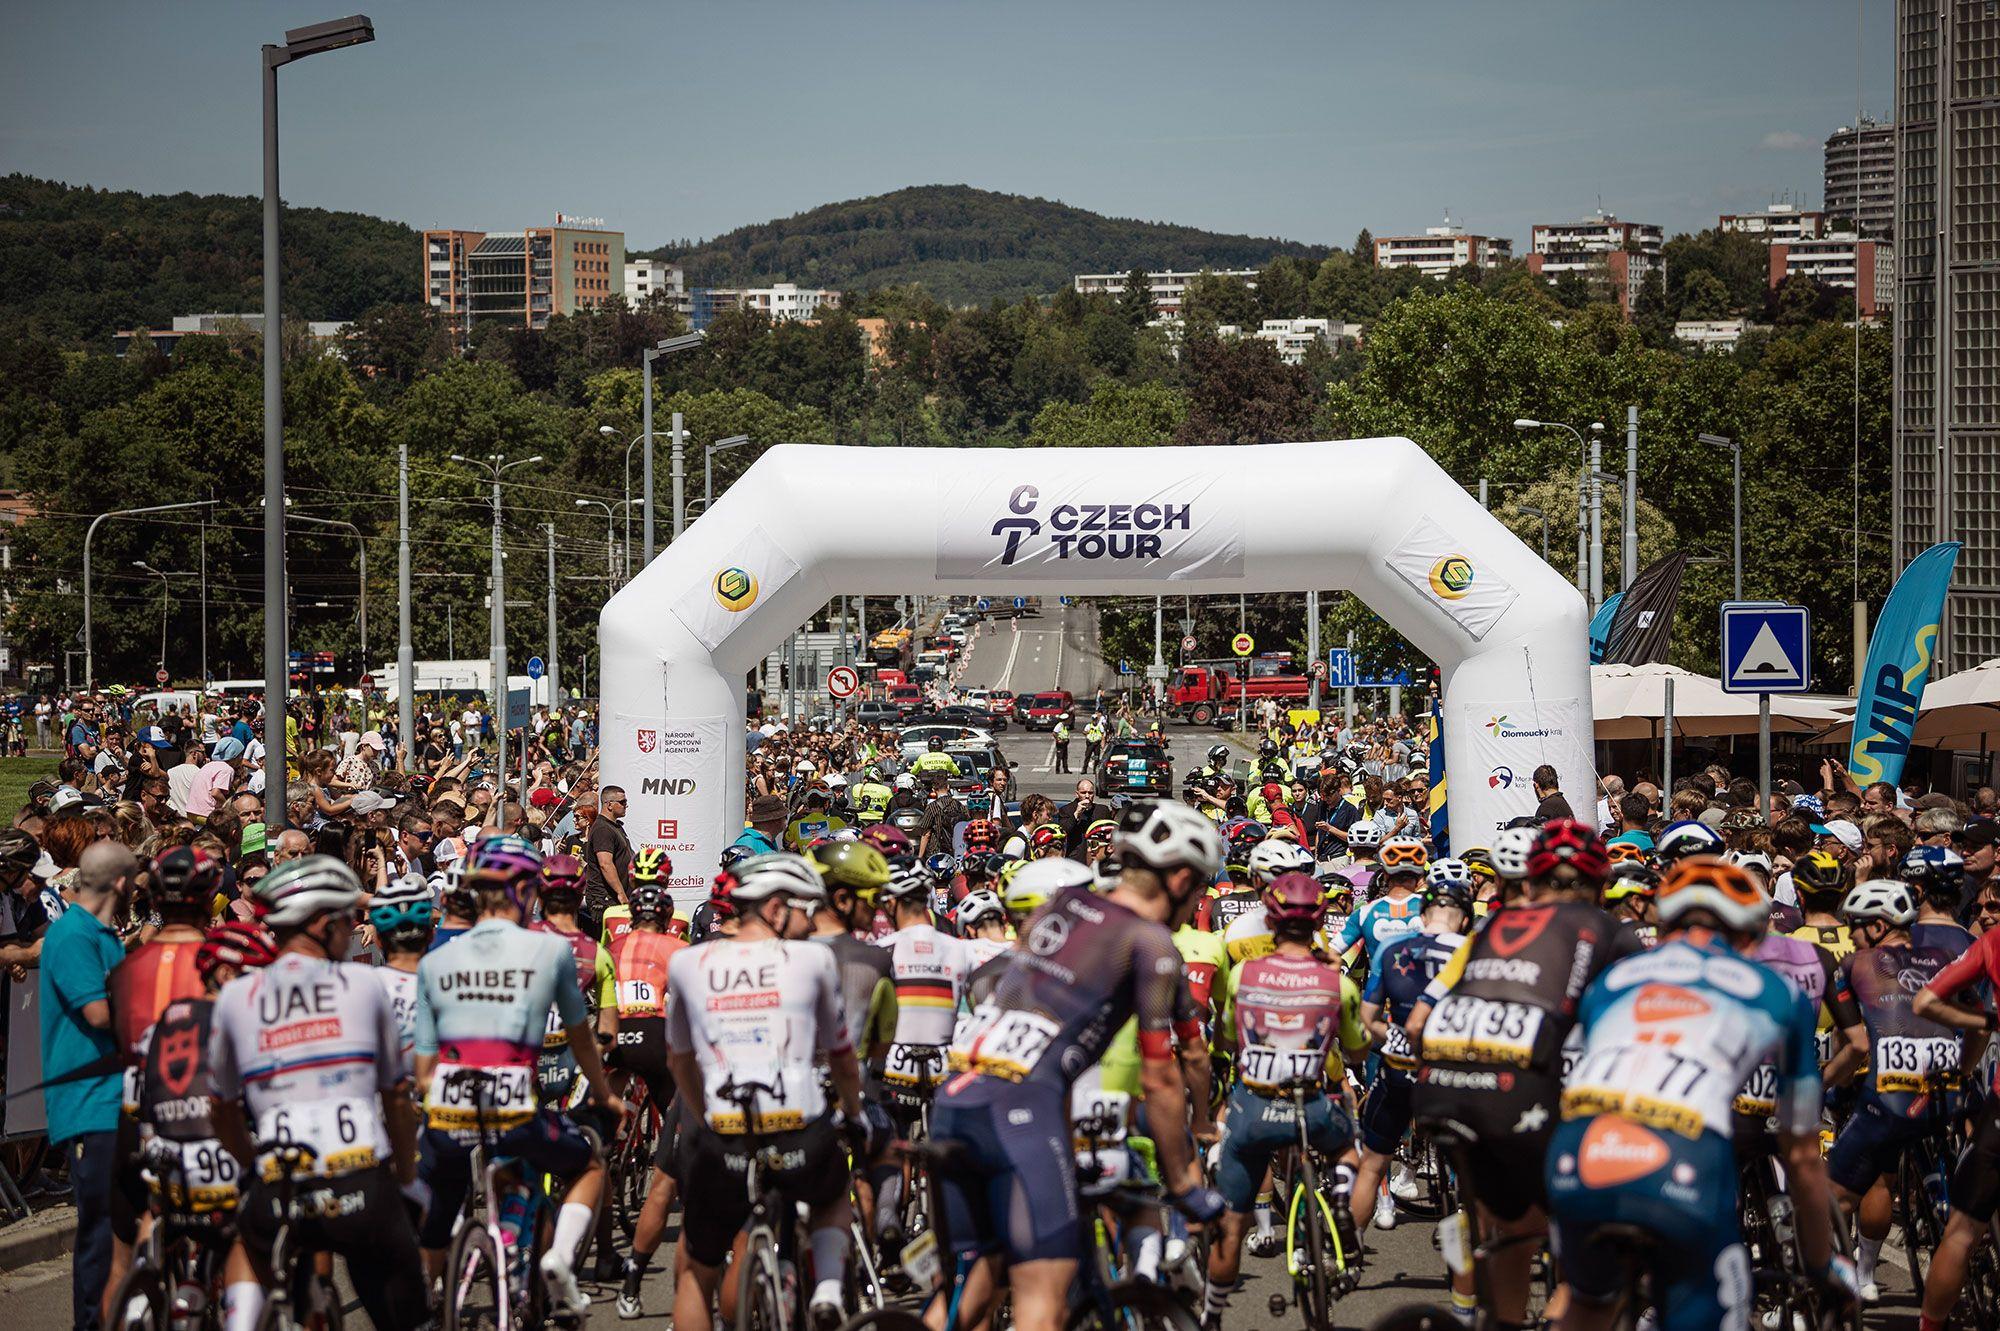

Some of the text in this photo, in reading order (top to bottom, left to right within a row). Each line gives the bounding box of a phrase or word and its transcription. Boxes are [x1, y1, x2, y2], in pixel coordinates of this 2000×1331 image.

[1050, 503, 1191, 532] CZECH
[1051, 533, 1162, 560] TOUR
[1236, 641, 1250, 649] STOP
[1866, 663, 1918, 756] VIP
[664, 731, 695, 739] NÁRODNÍ
[664, 738, 702, 747] SPORTOVNÍ
[1501, 728, 1563, 738] Olomoucký kraj
[641, 777, 696, 796] MND
[678, 843, 696, 852] ČEZ
[667, 876, 705, 887] zechia
[708, 964, 776, 993] UAE
[906, 964, 943, 975] TUDOR
[1258, 971, 1320, 988] FANTINI
[438, 969, 536, 992] UNIBET
[633, 982, 650, 1001] 16
[260, 983, 337, 1025] UAE
[1486, 1001, 1529, 1039] 93
[617, 1031, 645, 1045] EOS
[1881, 1041, 1918, 1072] 133
[538, 1066, 570, 1085] alia
[1428, 1067, 1499, 1091] TUDOR
[1656, 1052, 1709, 1098] 77
[275, 1104, 356, 1144] 6 6
[196, 1148, 236, 1183] 96
